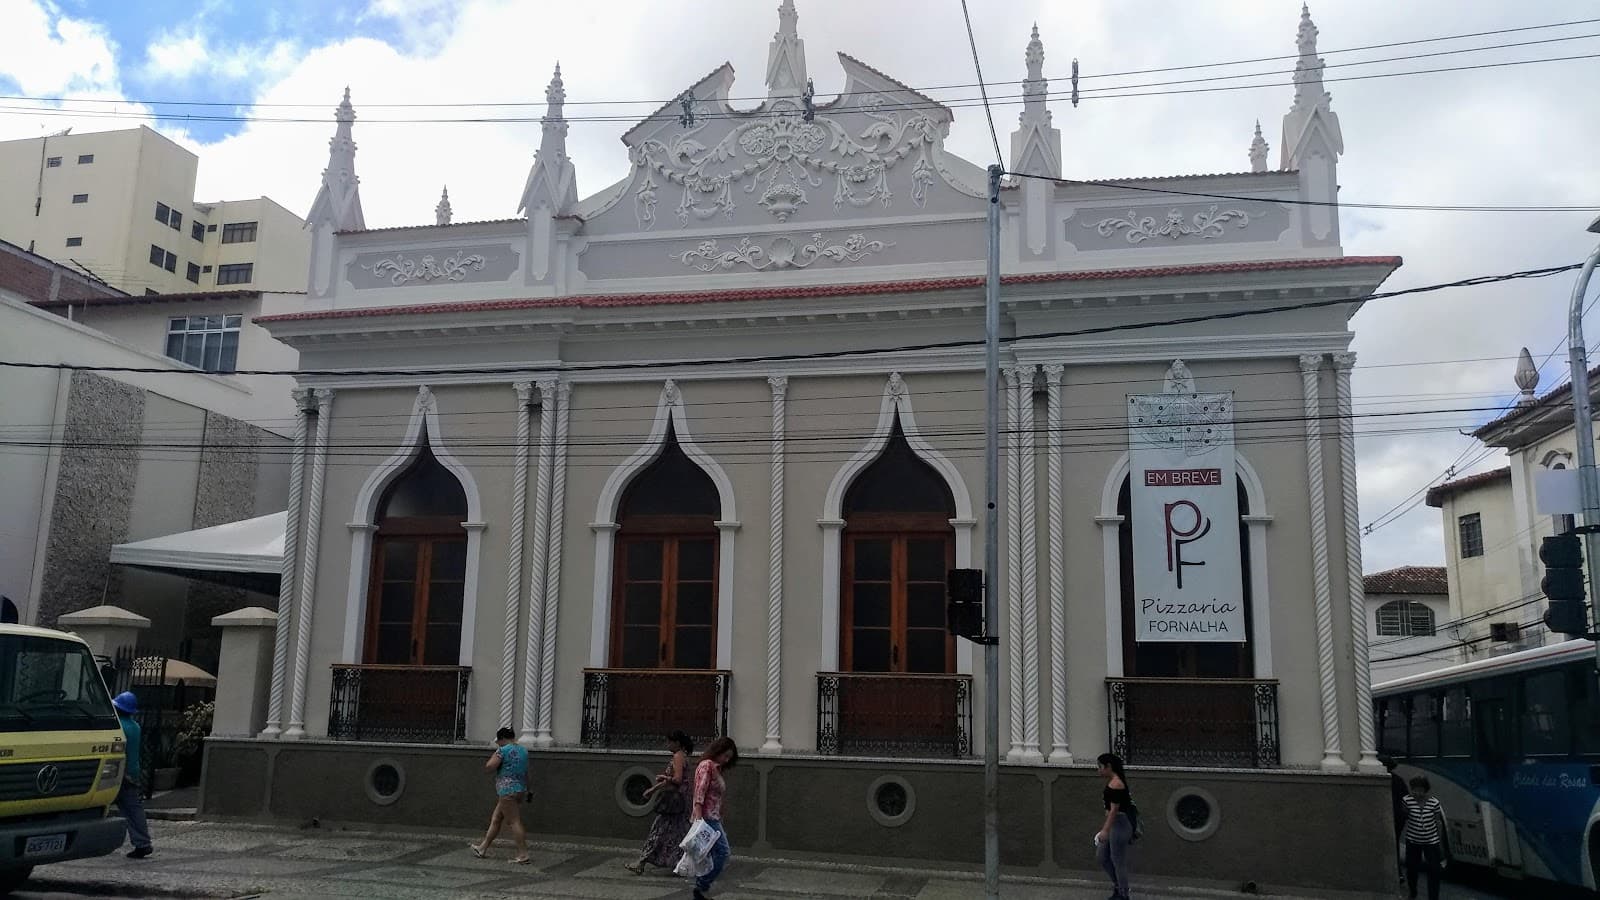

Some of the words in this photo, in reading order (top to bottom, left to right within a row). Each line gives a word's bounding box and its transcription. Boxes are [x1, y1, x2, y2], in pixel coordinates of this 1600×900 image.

[1147, 472, 1167, 484] EM
[1172, 471, 1219, 484] BREVE
[1141, 598, 1237, 615] Pizzaria
[1149, 620, 1228, 633] FORNALHA
